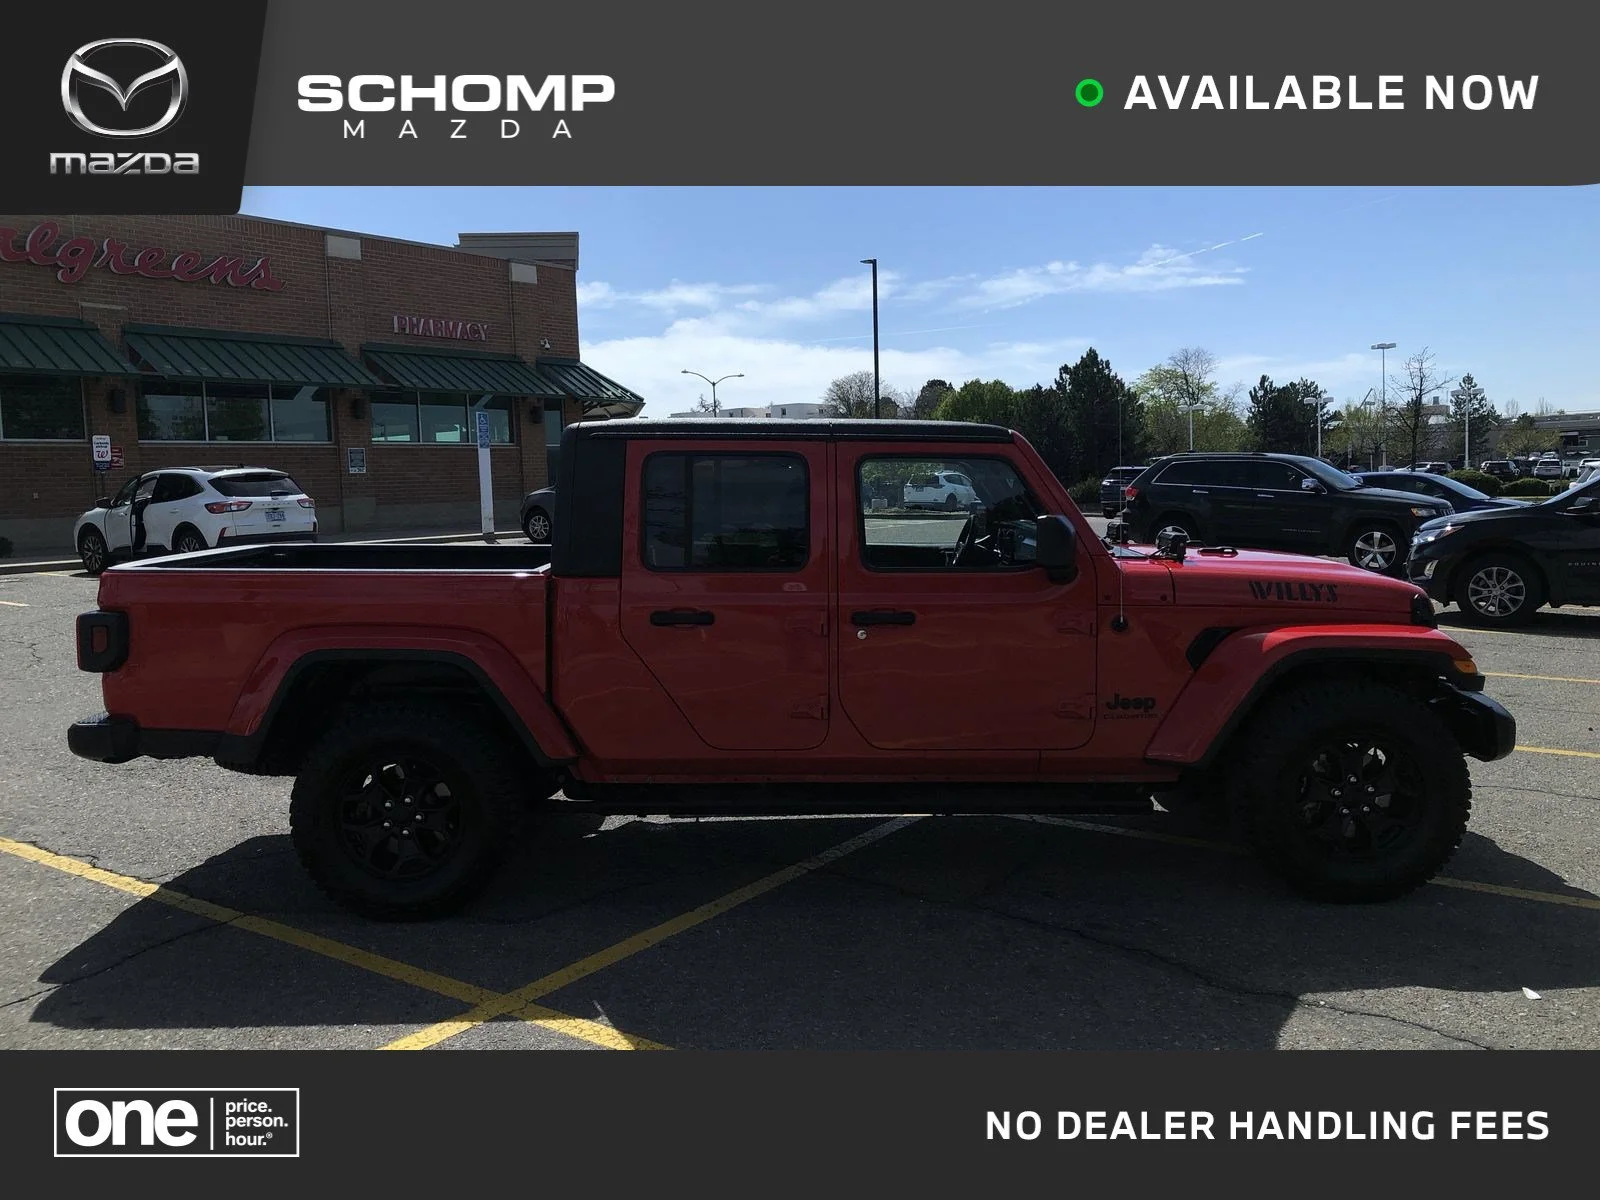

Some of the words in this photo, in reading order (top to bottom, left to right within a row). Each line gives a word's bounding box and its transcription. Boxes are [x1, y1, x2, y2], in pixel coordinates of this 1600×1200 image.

[392, 315, 488, 341] PHARMACY
[1248, 580, 1338, 602] WILLYS
[1105, 692, 1157, 712] Jeep
